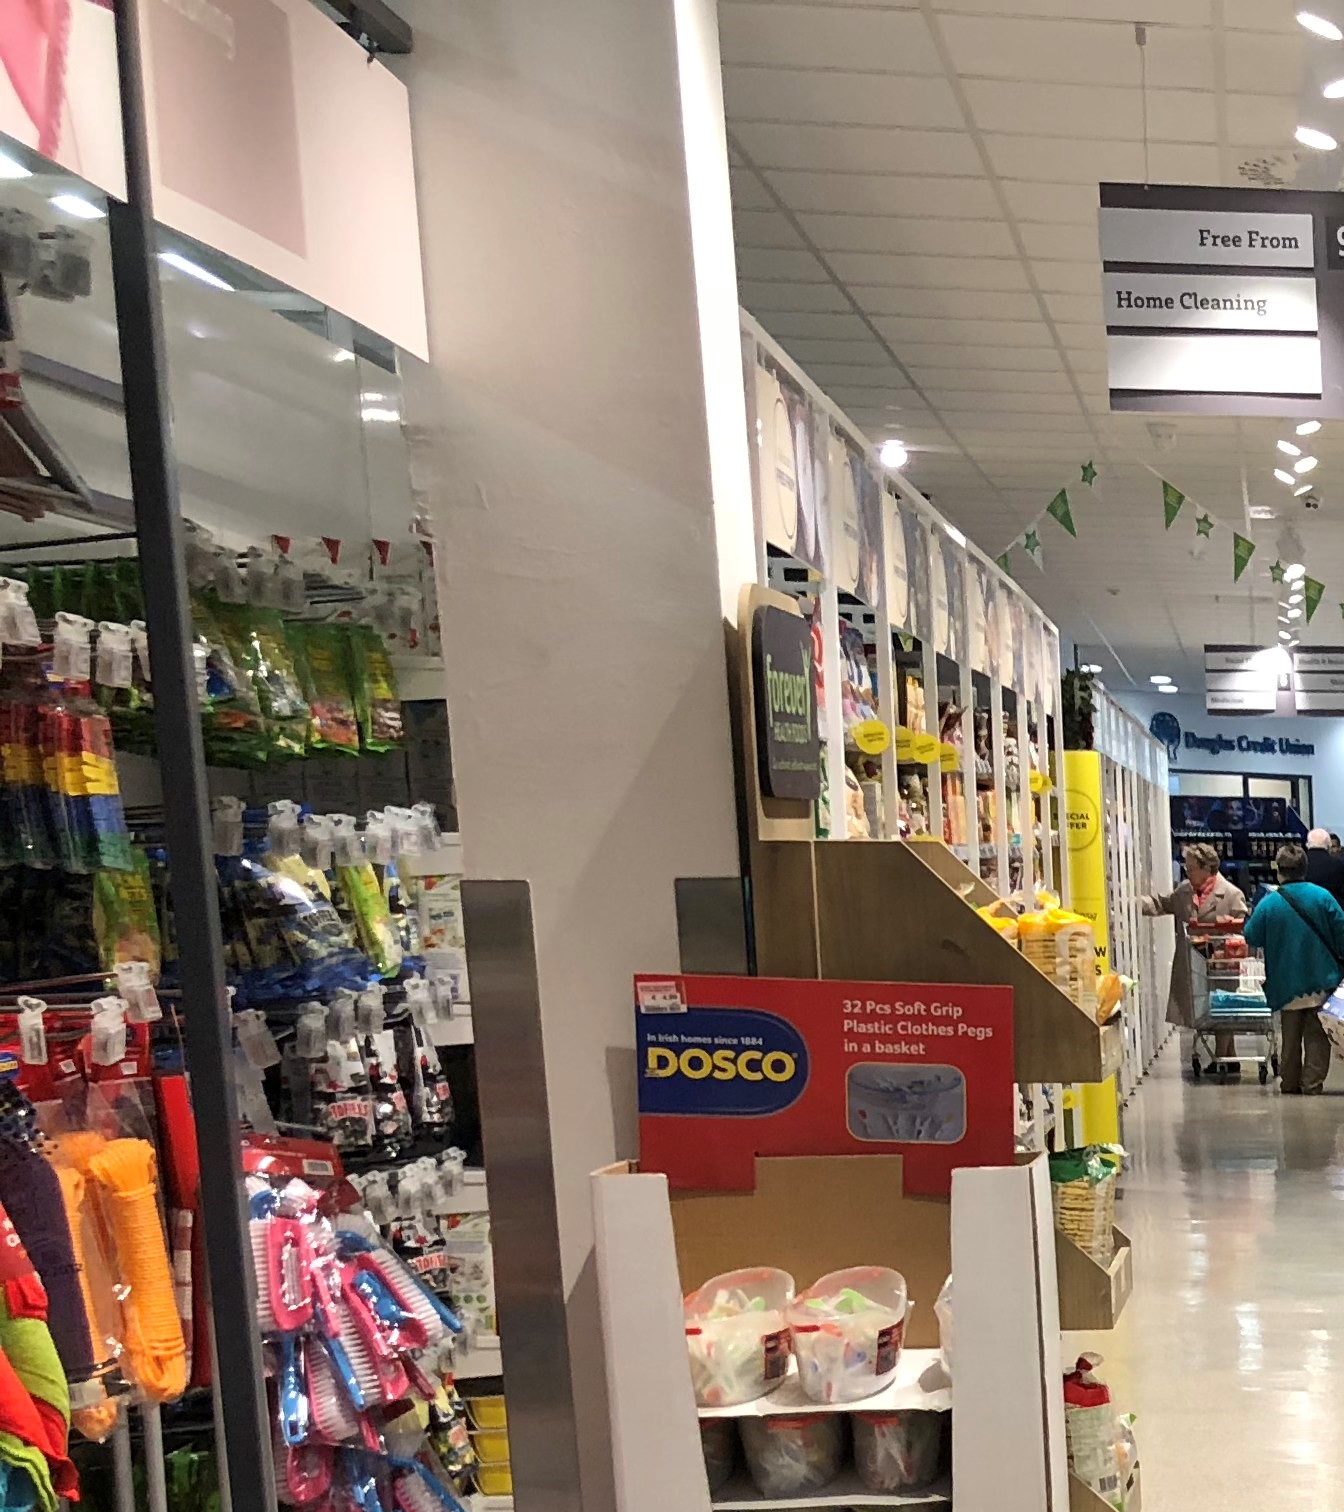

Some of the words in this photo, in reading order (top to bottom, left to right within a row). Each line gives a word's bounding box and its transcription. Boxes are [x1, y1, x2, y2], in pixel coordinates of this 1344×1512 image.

[1198, 229, 1242, 249] Free
[1247, 231, 1300, 250] From
[1116, 291, 1174, 311] Home
[1179, 292, 1267, 316] Cleaning
[1237, 735, 1277, 753] Credit
[1278, 737, 1314, 755] Union
[843, 1000, 862, 1015] 32
[866, 1001, 891, 1015] Pcs
[895, 1001, 927, 1016] Soft
[930, 1002, 963, 1020] Grip
[647, 1033, 656, 1041] In
[658, 1034, 679, 1042] Irish
[681, 1035, 712, 1044] homes
[714, 1036, 738, 1045] since
[843, 1020, 893, 1035] Plastic
[896, 1021, 954, 1036] Clothes
[957, 1023, 993, 1042] Pegs
[843, 1039, 856, 1053] in
[860, 1043, 871, 1054] a
[873, 1039, 926, 1056] basket
[647, 1046, 796, 1082] DOSCO
